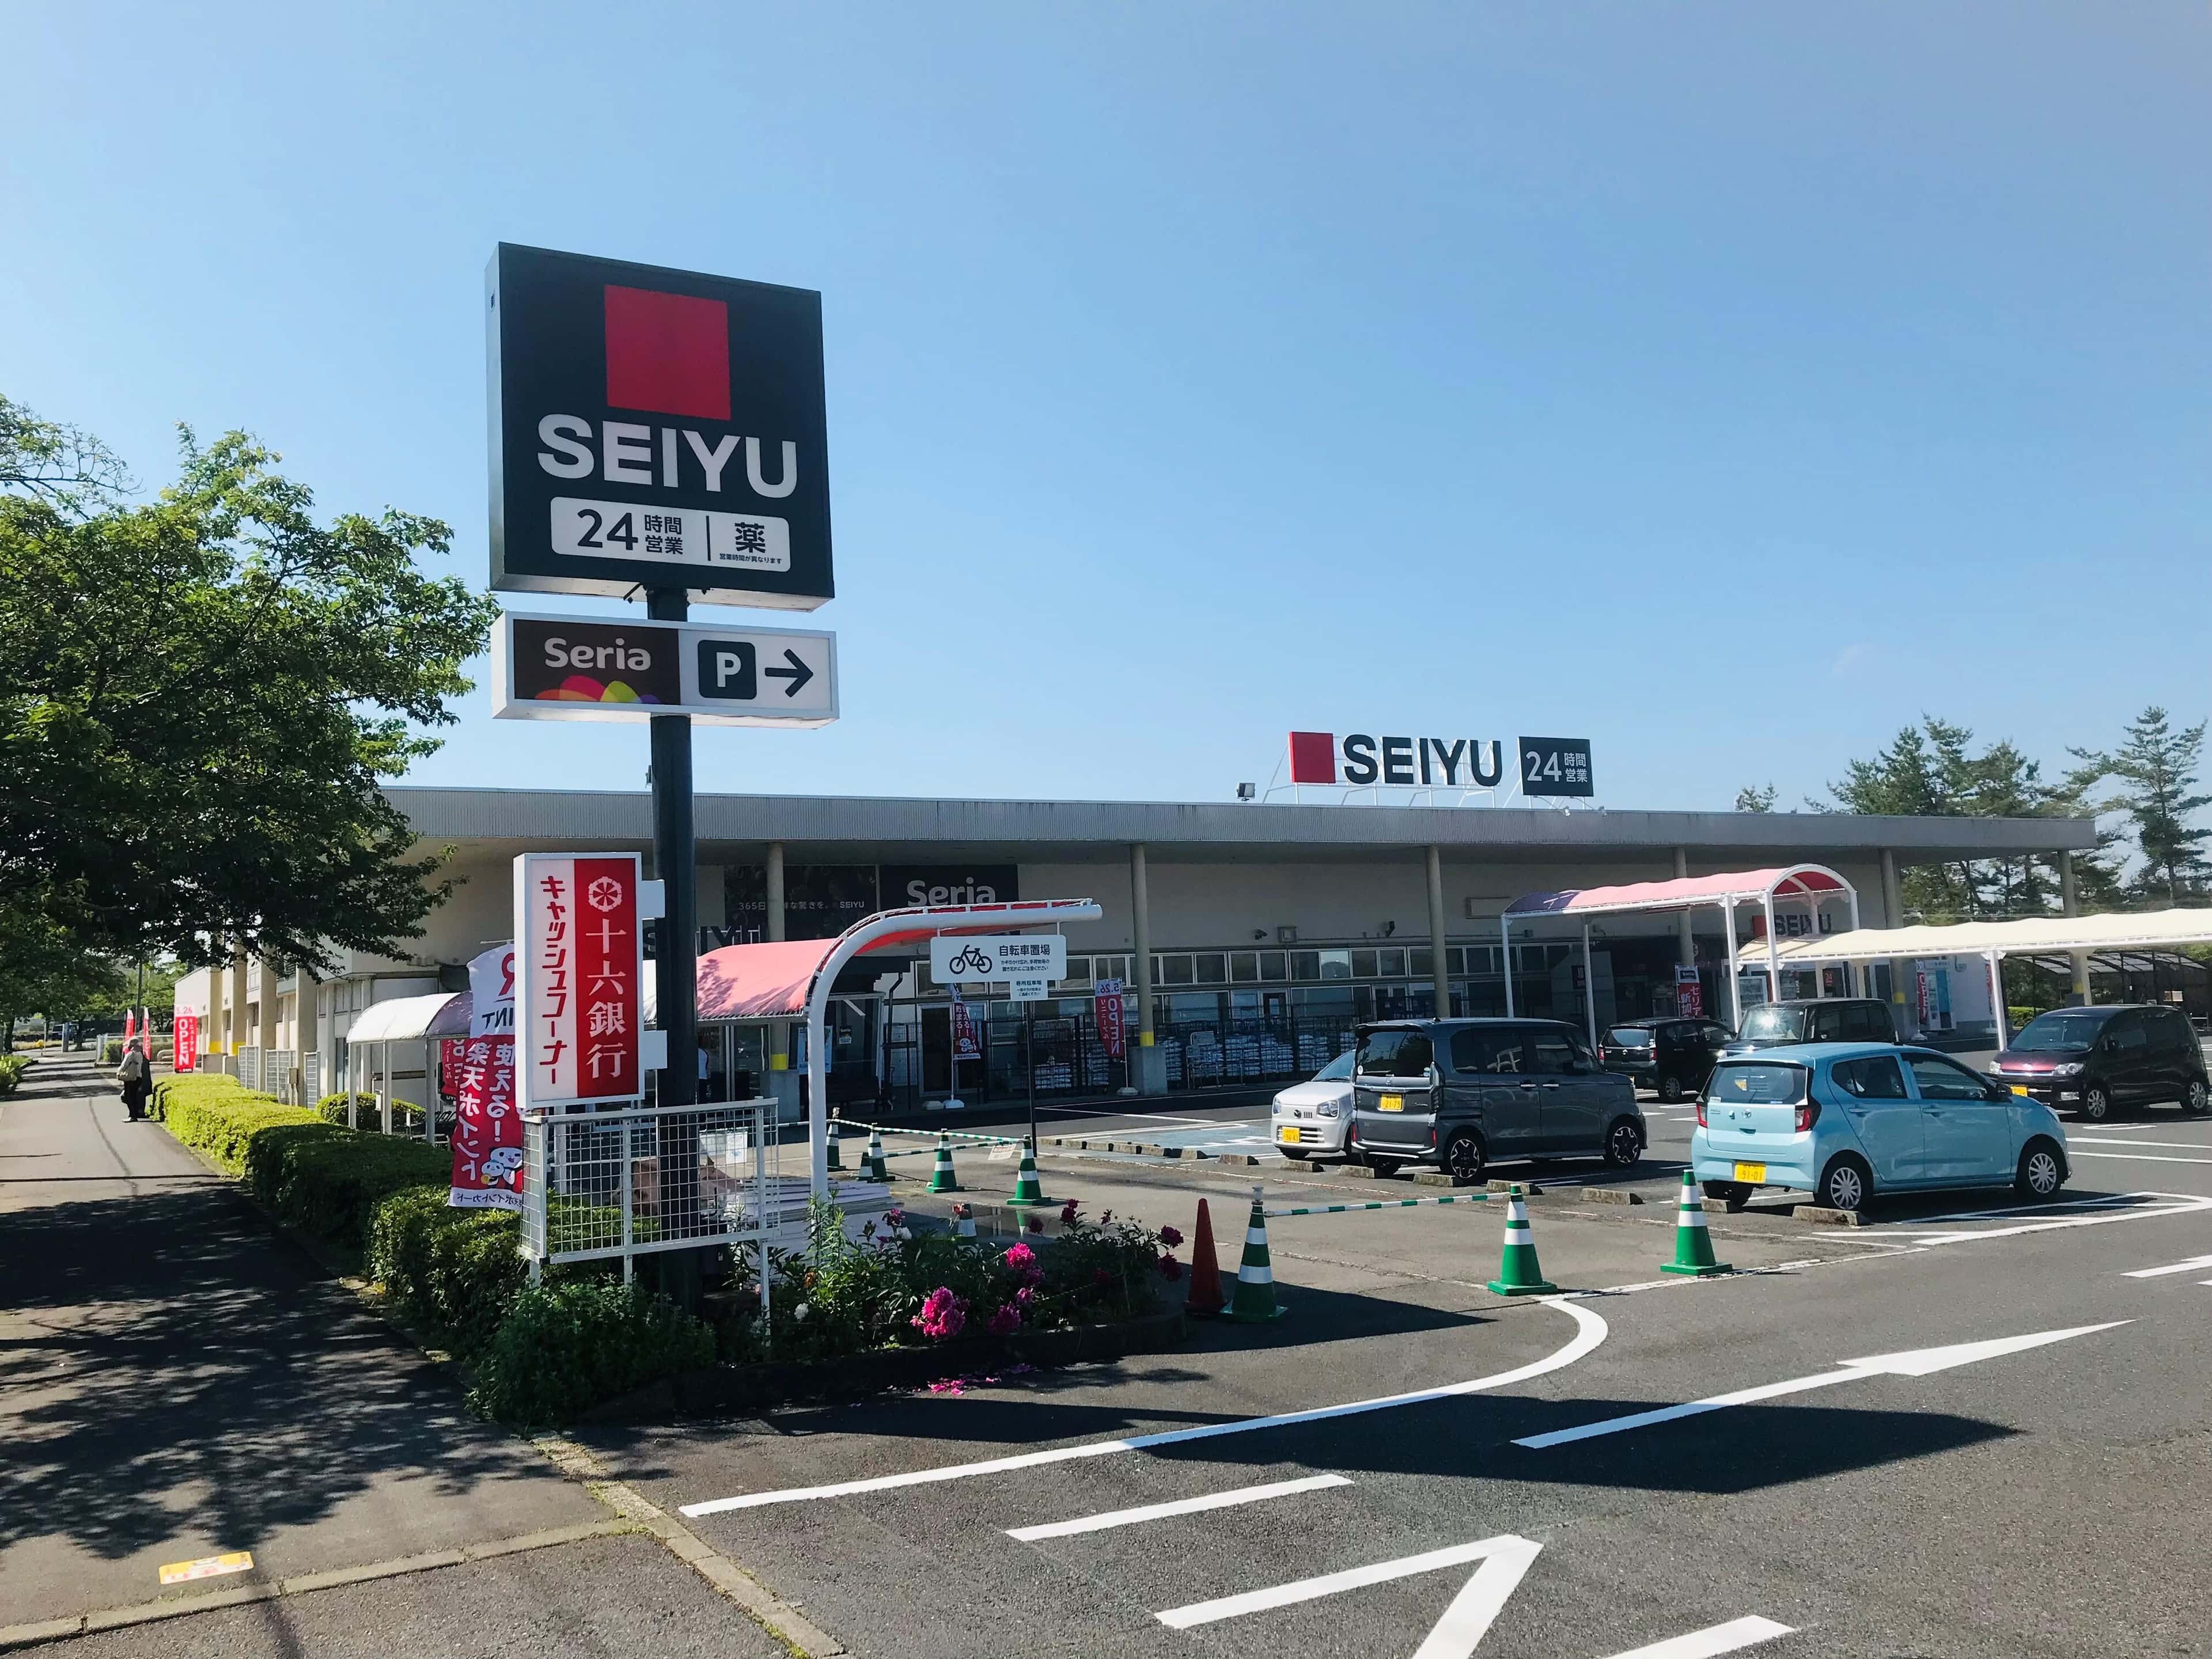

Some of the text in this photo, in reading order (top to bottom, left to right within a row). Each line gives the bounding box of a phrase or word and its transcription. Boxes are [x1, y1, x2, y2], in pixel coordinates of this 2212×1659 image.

[537, 414, 798, 499] SEIYU
[577, 508, 682, 551] 24 時間
[645, 535, 683, 555] 営業
[734, 522, 766, 553] 薬
[544, 637, 652, 672] Seria
[716, 652, 741, 688] P
[1342, 733, 1502, 787] SEIYU
[1526, 751, 1586, 782] 24 時間
[1565, 767, 1588, 783] 営業
[907, 876, 996, 908] Seria
[999, 944, 1051, 956] 自転車置場
[539, 876, 568, 1085] キャッシュコーナー
[585, 918, 628, 1079] 十六銀行
[179, 1018, 190, 1066] OPEN
